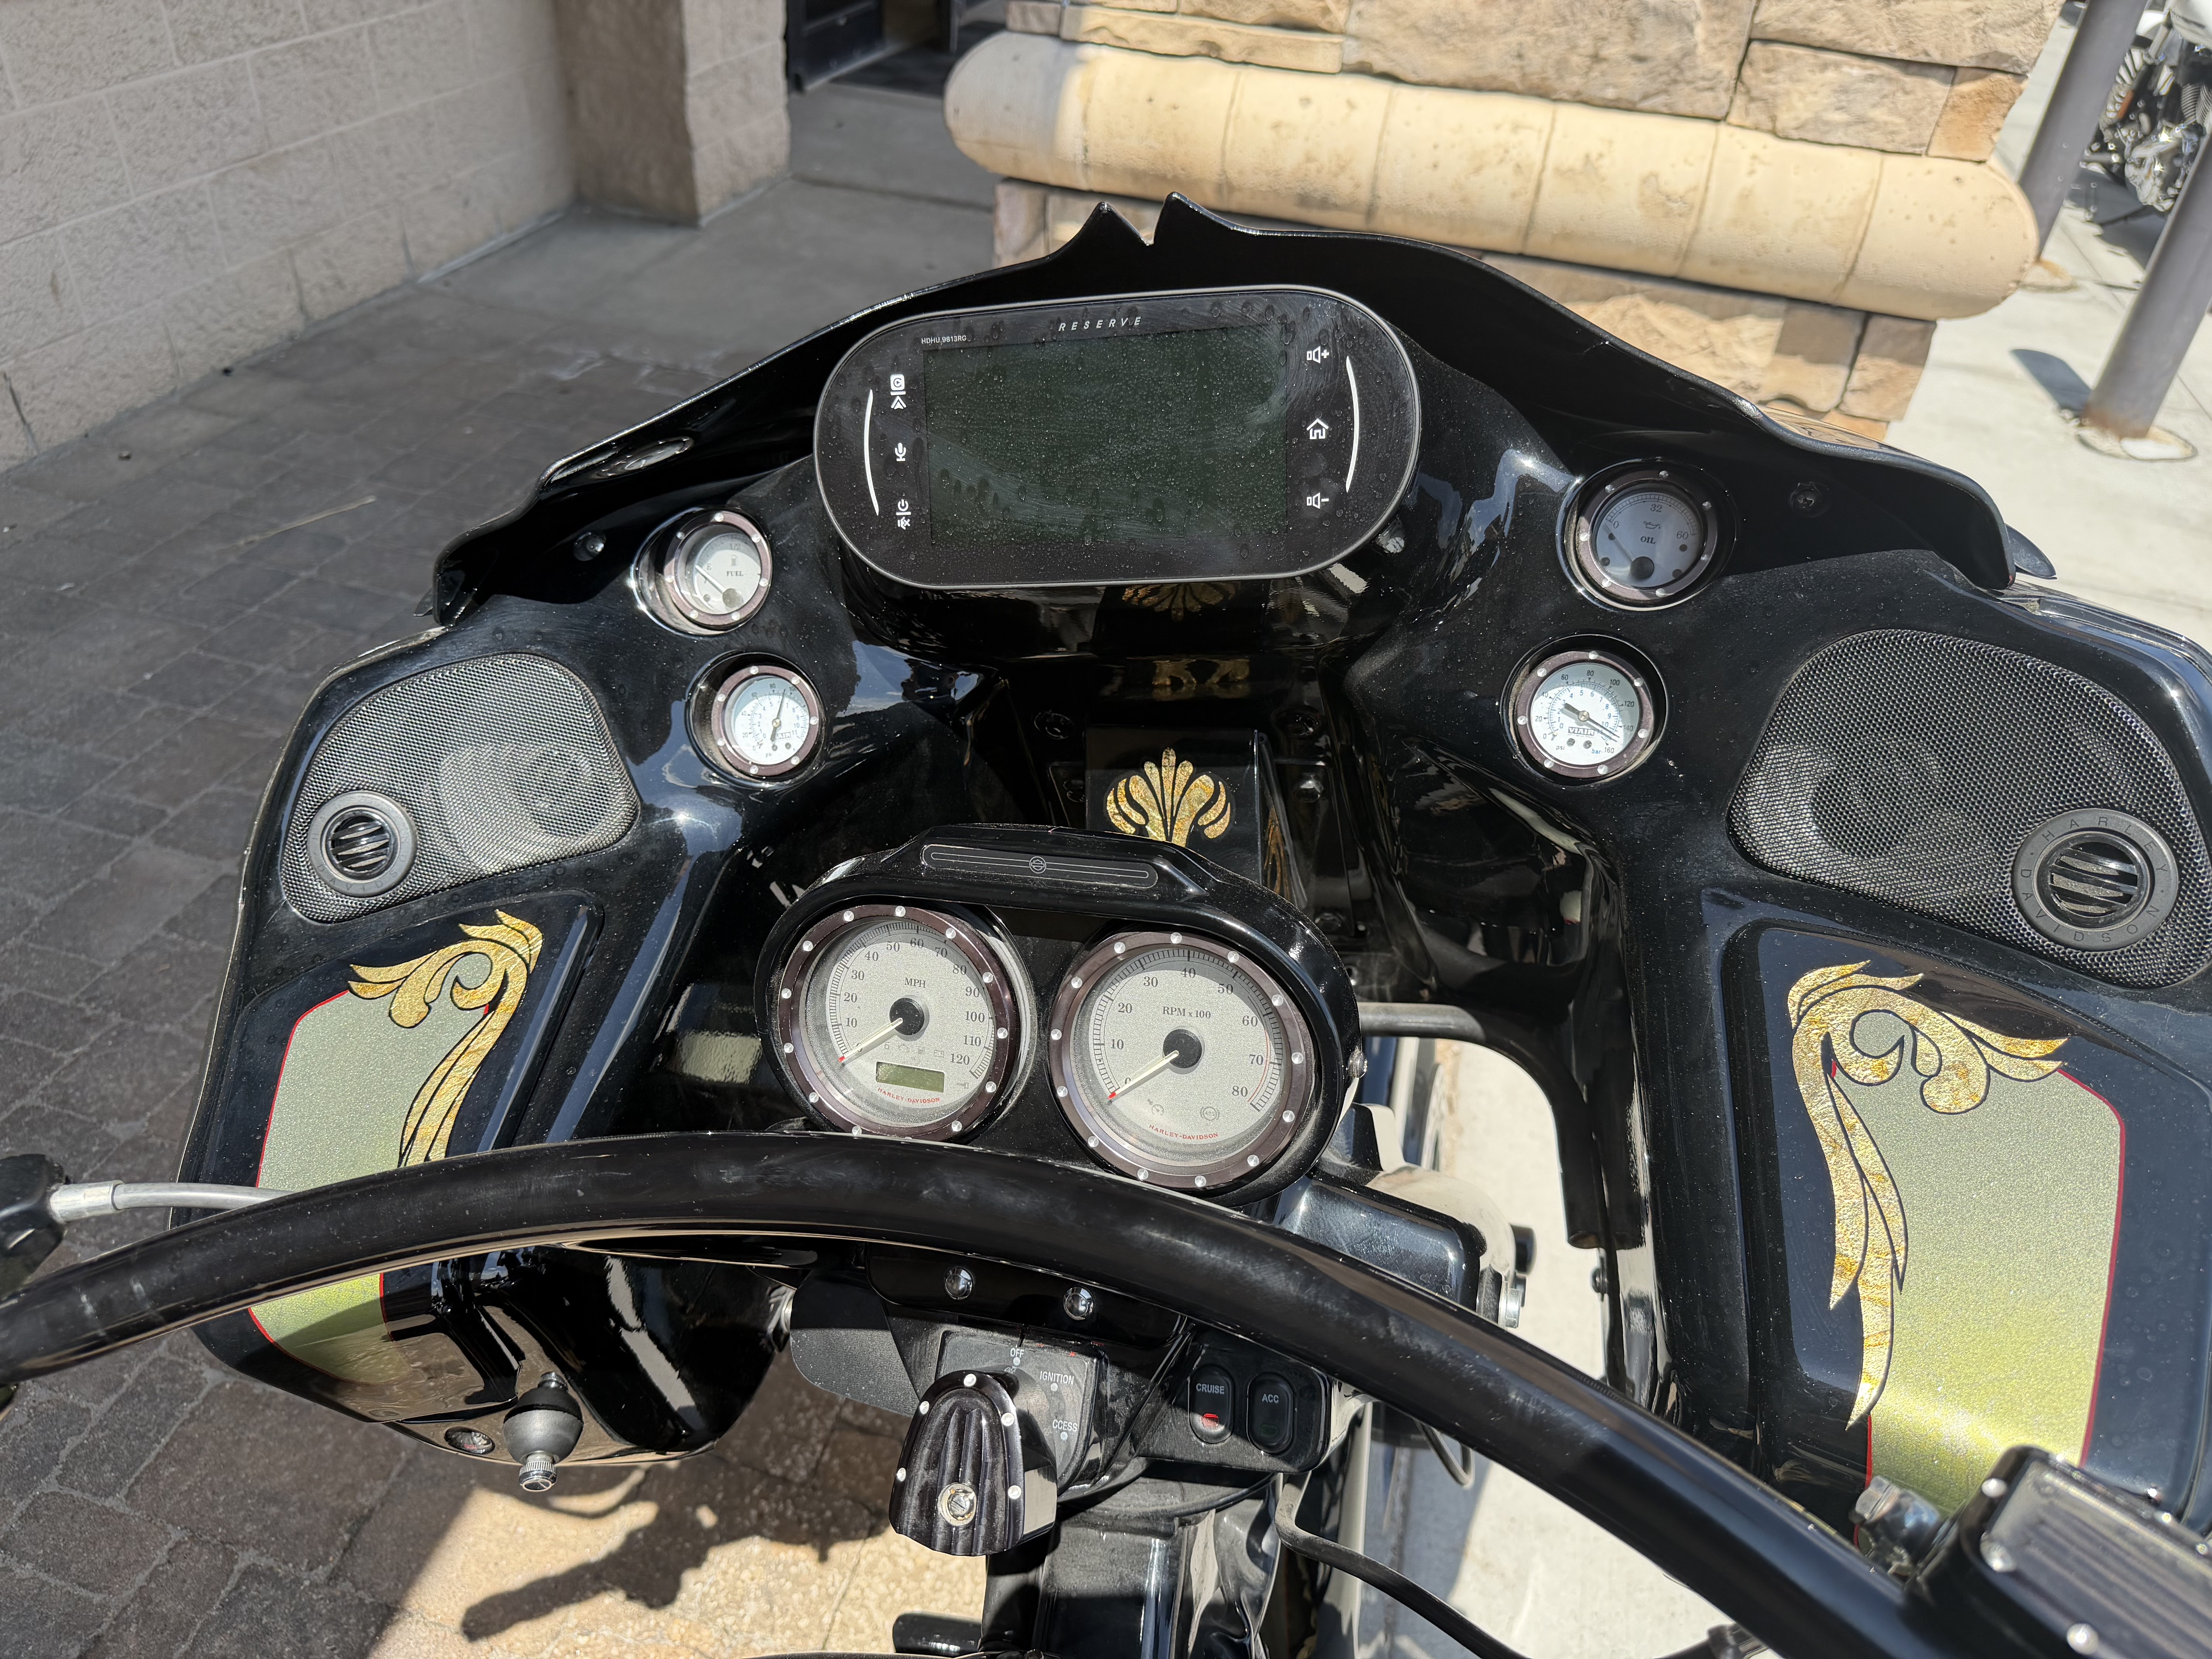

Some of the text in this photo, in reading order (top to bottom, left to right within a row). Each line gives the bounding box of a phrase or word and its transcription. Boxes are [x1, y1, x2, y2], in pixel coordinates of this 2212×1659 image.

[1058, 316, 1141, 331] RESERVE
[1650, 504, 1662, 512] 32
[1640, 536, 1656, 544] OIL
[1676, 531, 1688, 539] 60
[1568, 727, 1595, 736] VIAIR
[2042, 816, 2168, 872] HARLEY
[2020, 869, 2160, 943] DAVIDSON
[886, 941, 900, 952] 50
[910, 938, 924, 948] 60
[864, 951, 879, 962] 40
[934, 946, 948, 958] 70
[952, 964, 967, 975] 80
[1180, 968, 1196, 979] 40
[852, 970, 865, 981] 30
[904, 977, 926, 988] MPH
[1143, 976, 1158, 988] 30
[965, 986, 979, 998] 90
[1218, 984, 1233, 994] 50
[843, 992, 857, 1003] 20
[1118, 1002, 1133, 1014] 20
[1162, 1006, 1186, 1017] RPM
[1195, 1010, 1211, 1019] 100
[846, 1017, 857, 1028] 10
[965, 1011, 985, 1023] 100
[1242, 1015, 1258, 1027] 60
[963, 1035, 981, 1047] 110
[1111, 1039, 1124, 1050] 10
[950, 1053, 970, 1065] 120
[1249, 1054, 1264, 1065] 70
[1232, 1085, 1248, 1097] 80
[1149, 1124, 1219, 1140] HARLEY-DAVIDSON
[1010, 1347, 1025, 1358] OFF
[1040, 1370, 1074, 1385] IGNITION
[1196, 1382, 1225, 1395] CRUISE
[1262, 1393, 1279, 1403] ACC
